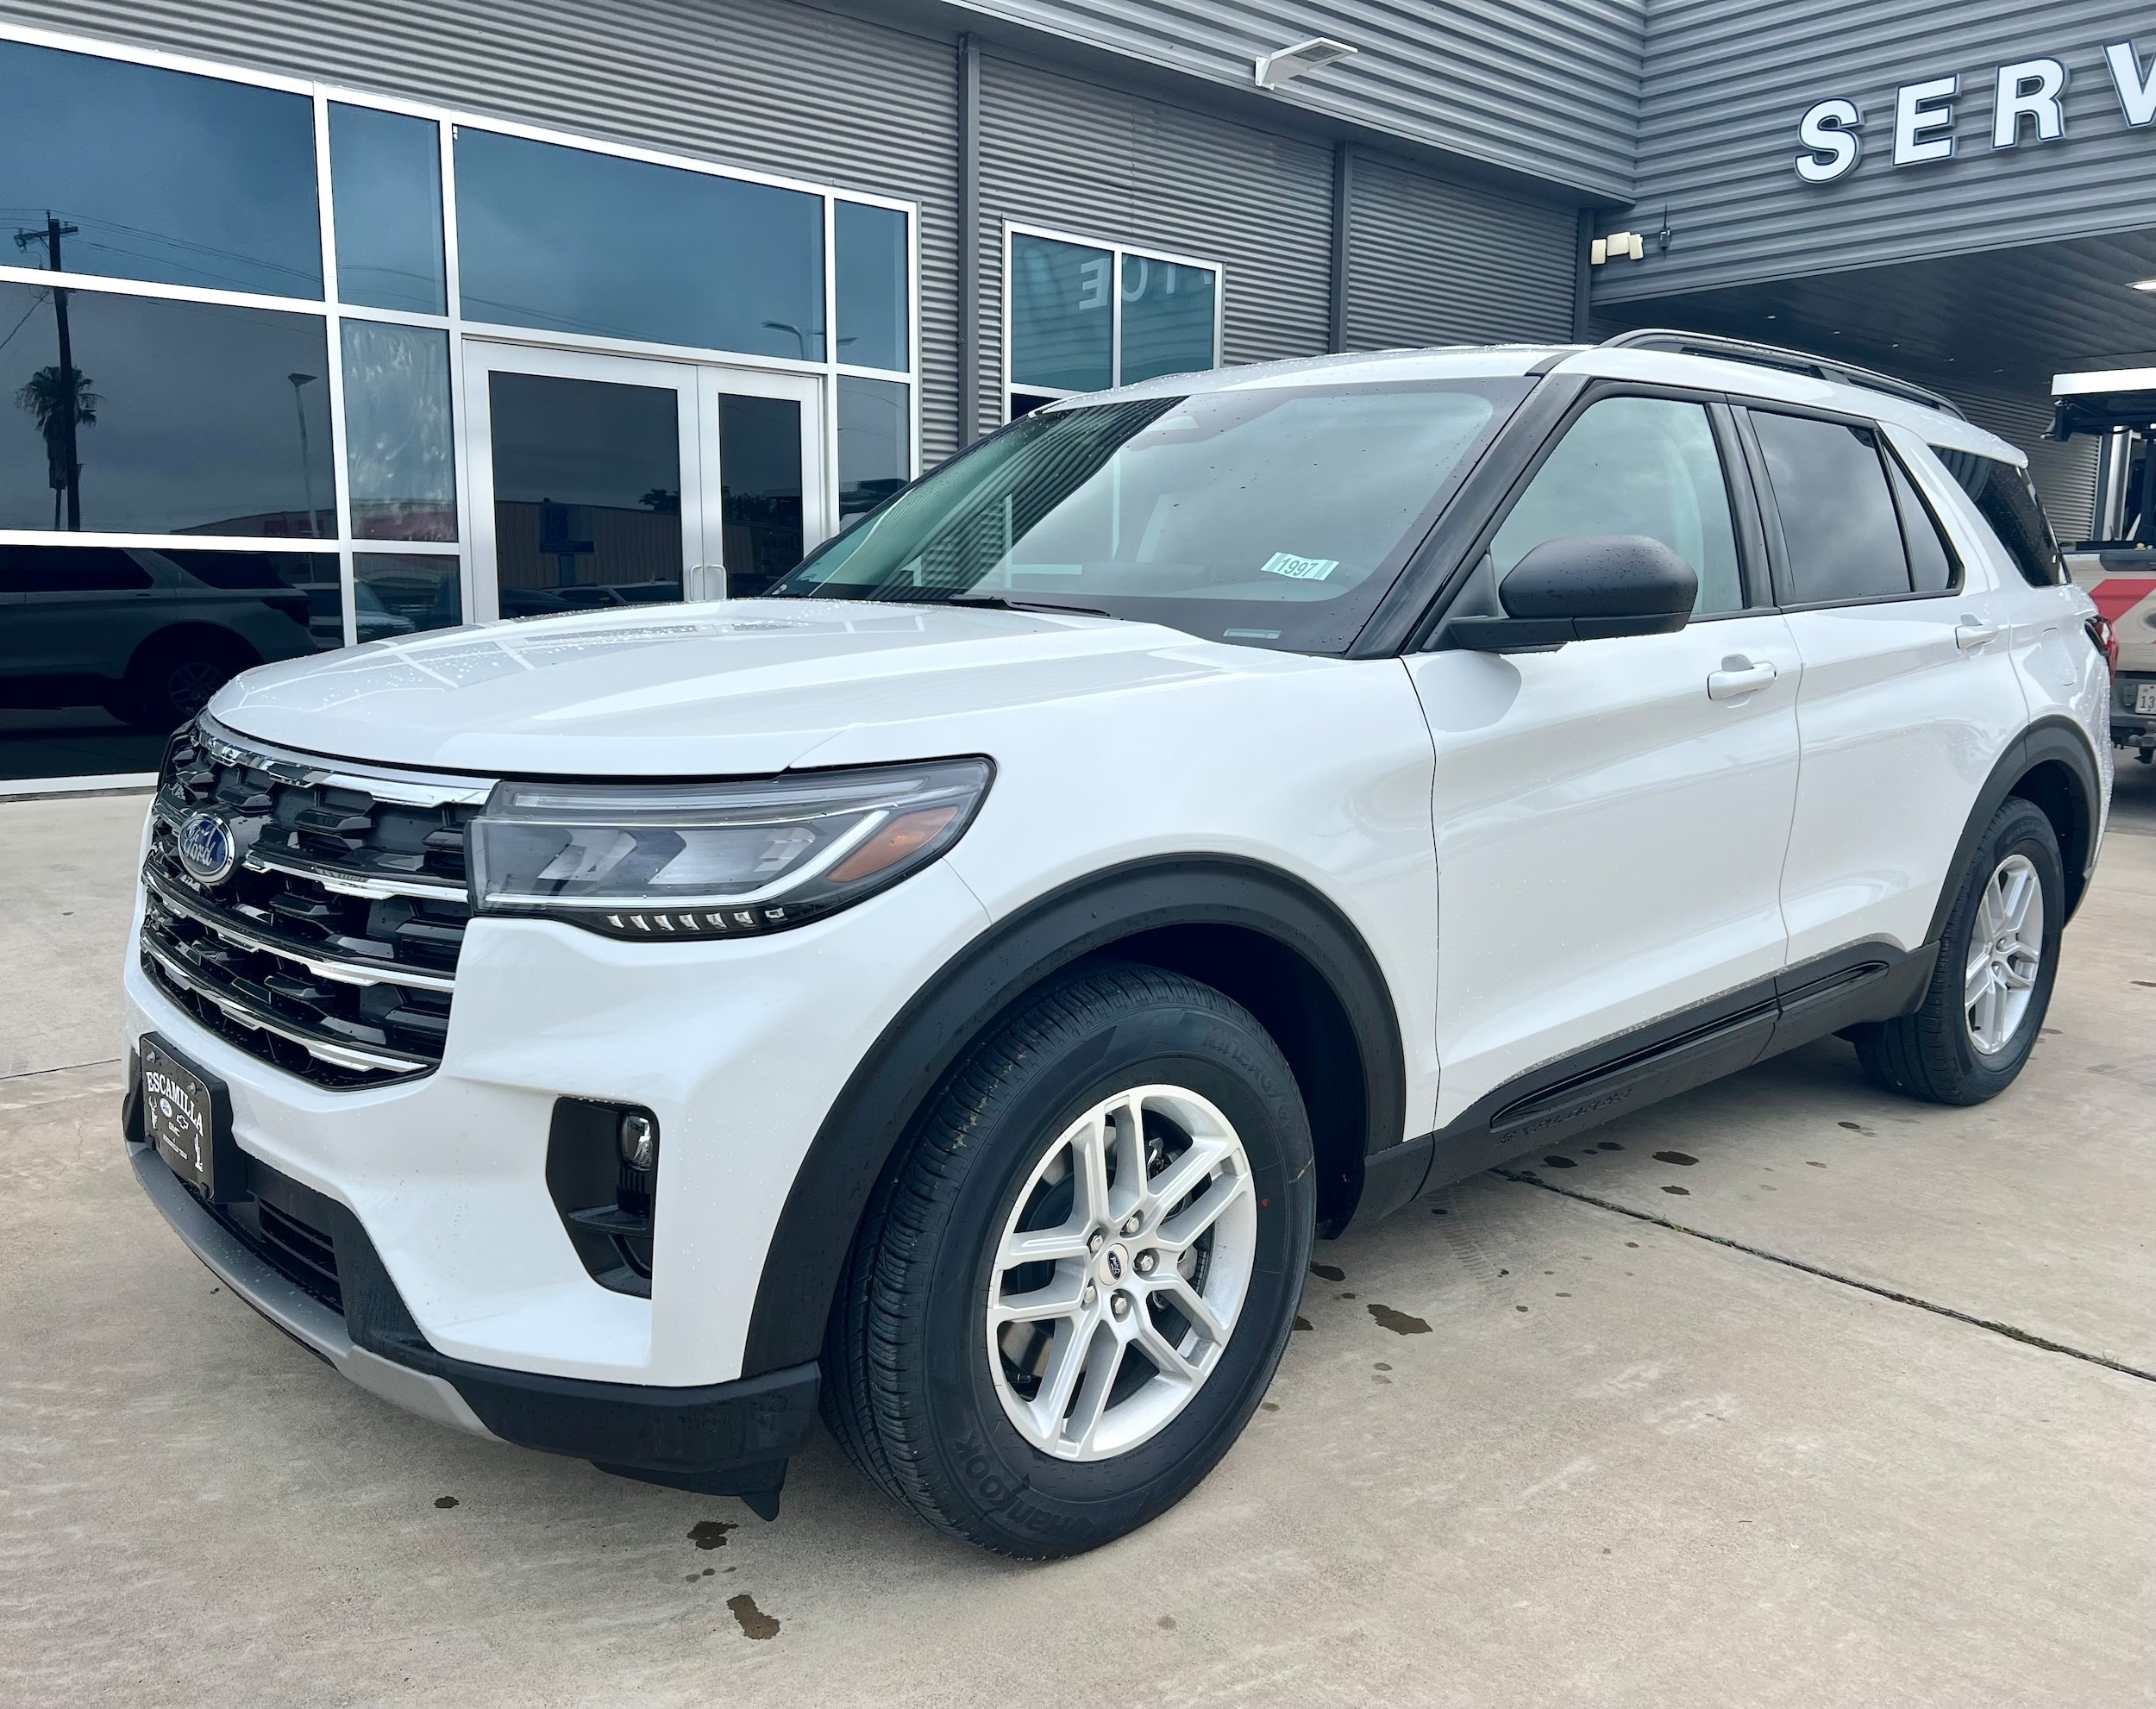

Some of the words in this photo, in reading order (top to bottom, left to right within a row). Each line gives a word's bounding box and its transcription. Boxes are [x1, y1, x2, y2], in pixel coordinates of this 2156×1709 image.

[1277, 558, 1319, 577] 1997
[184, 823, 216, 867] Ford
[146, 1071, 204, 1136] ESCAMILLA
